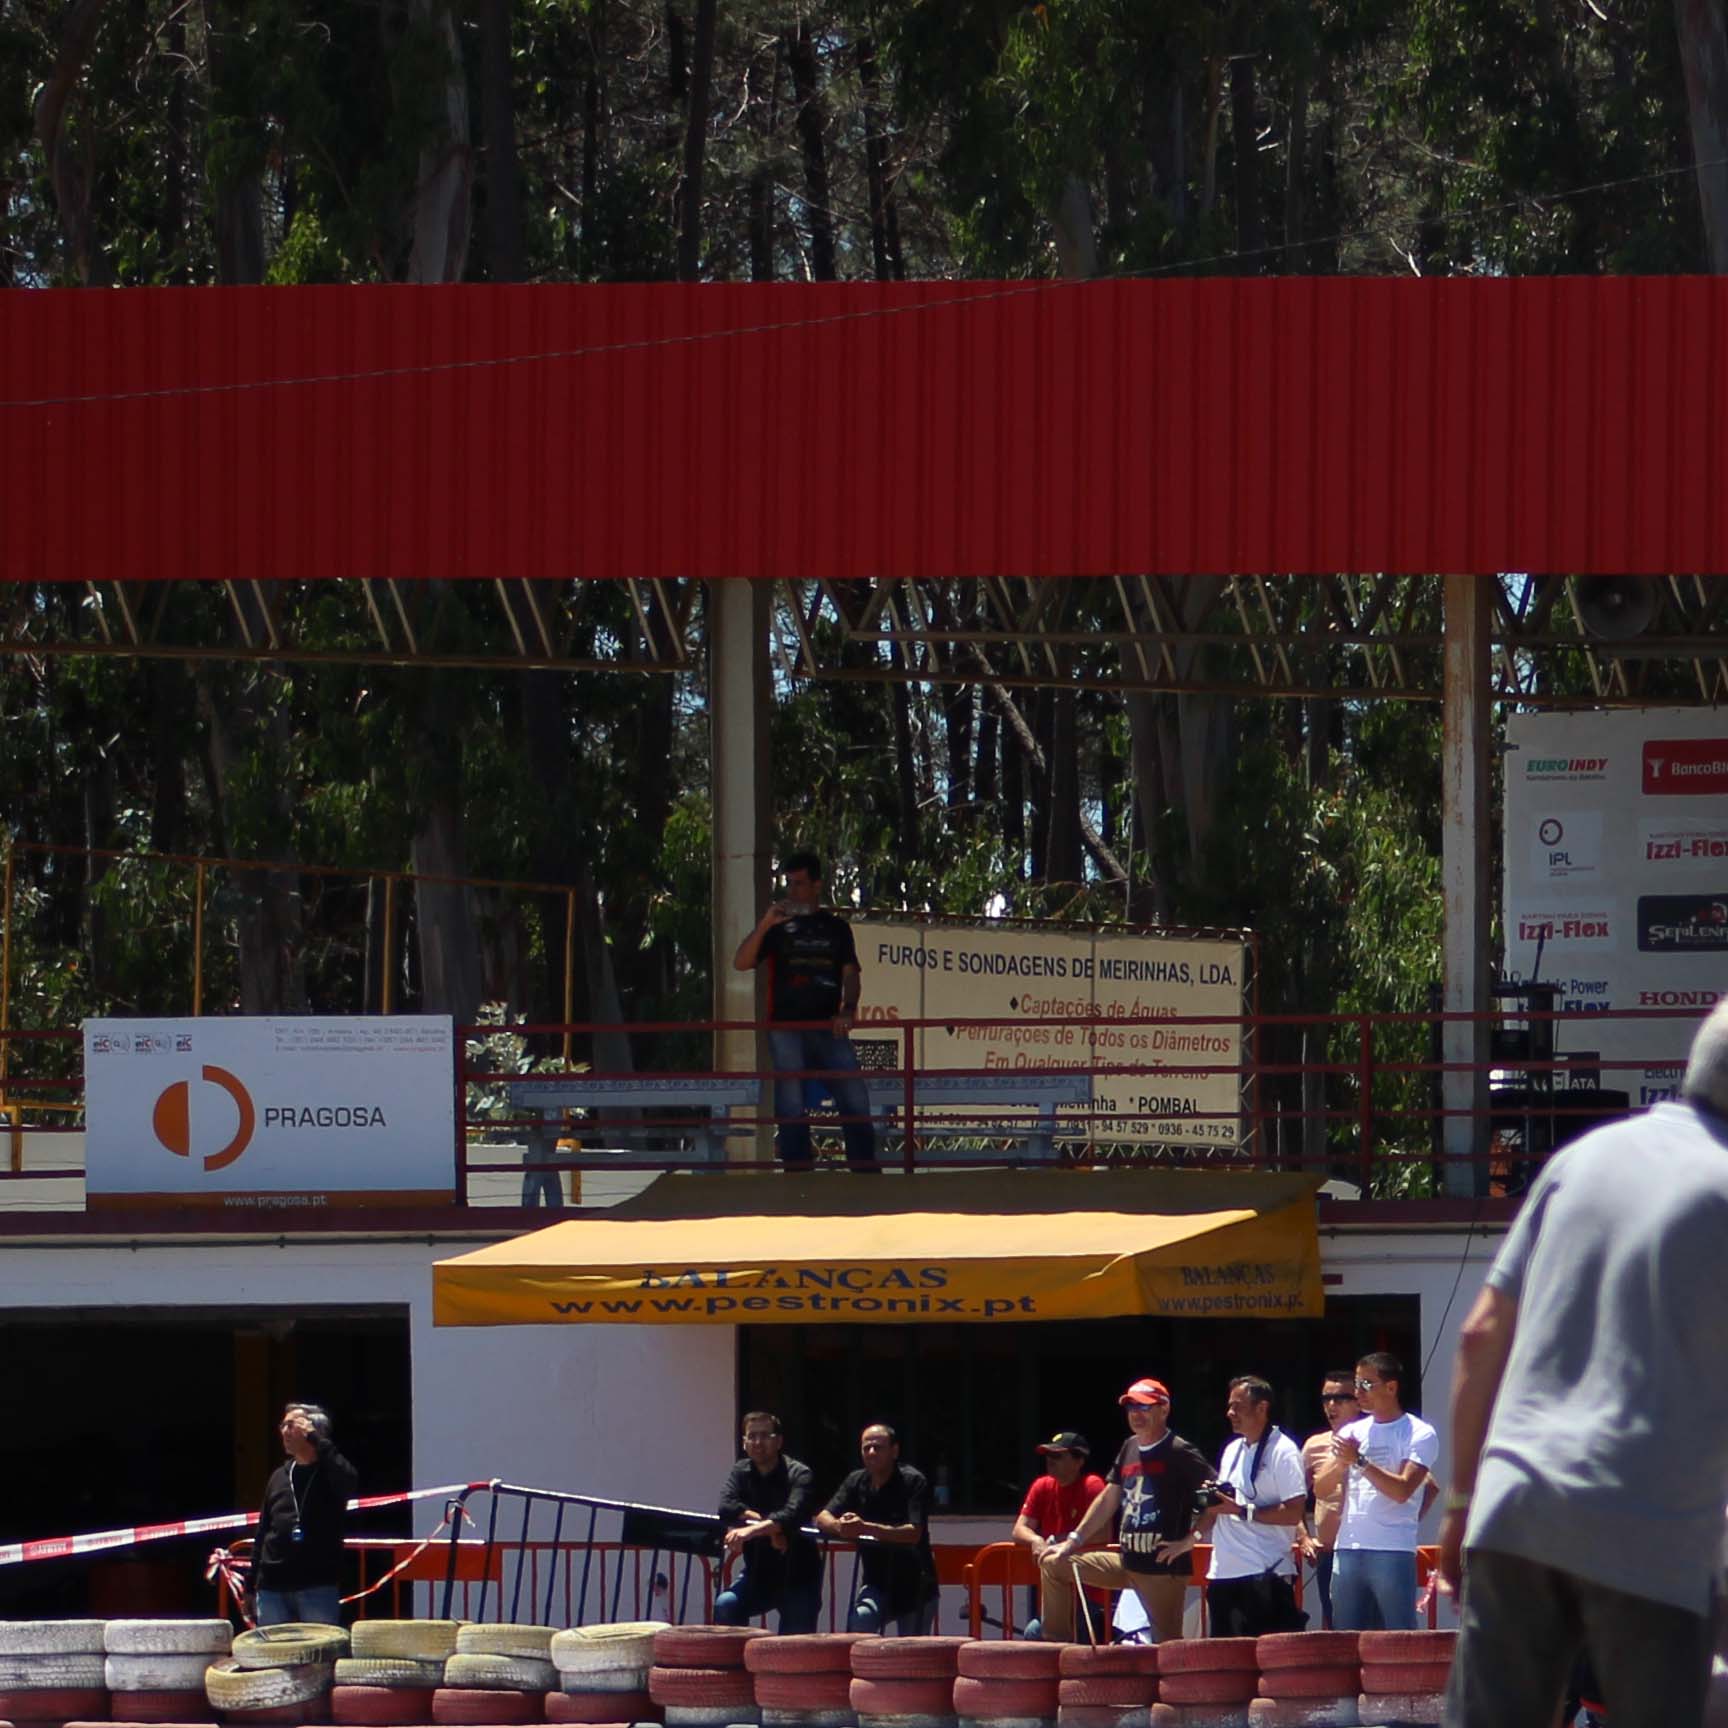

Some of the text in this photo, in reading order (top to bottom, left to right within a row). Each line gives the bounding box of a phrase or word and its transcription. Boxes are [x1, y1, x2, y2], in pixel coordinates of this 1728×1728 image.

[1526, 759, 1609, 773] EUROINDY
[1548, 852, 1573, 866] IPL
[879, 943, 1238, 987] FUROS E SONDAGENS DE MEIRINHAS, LDA.
[1570, 979, 1608, 995] Power
[1021, 993, 1101, 1018] Captações
[1107, 997, 1126, 1018] de
[1638, 991, 1721, 1006] HOND
[1055, 1026, 1074, 1047] de
[1080, 1026, 1125, 1049] Todos
[1130, 1033, 1148, 1049] os
[1152, 1028, 1231, 1053] Diâmetros
[985, 1051, 1009, 1070] Em
[1138, 1096, 1201, 1114] POMBAL
[265, 1107, 387, 1127] PRAGOSA
[1131, 1122, 1149, 1135] 529
[1158, 1122, 1183, 1135] 0936
[1191, 1124, 1205, 1136] 45
[1222, 1125, 1235, 1138] 29
[223, 1194, 327, 1209] www.pragosa.pt
[552, 1291, 1037, 1317] www.pestronix.pt
